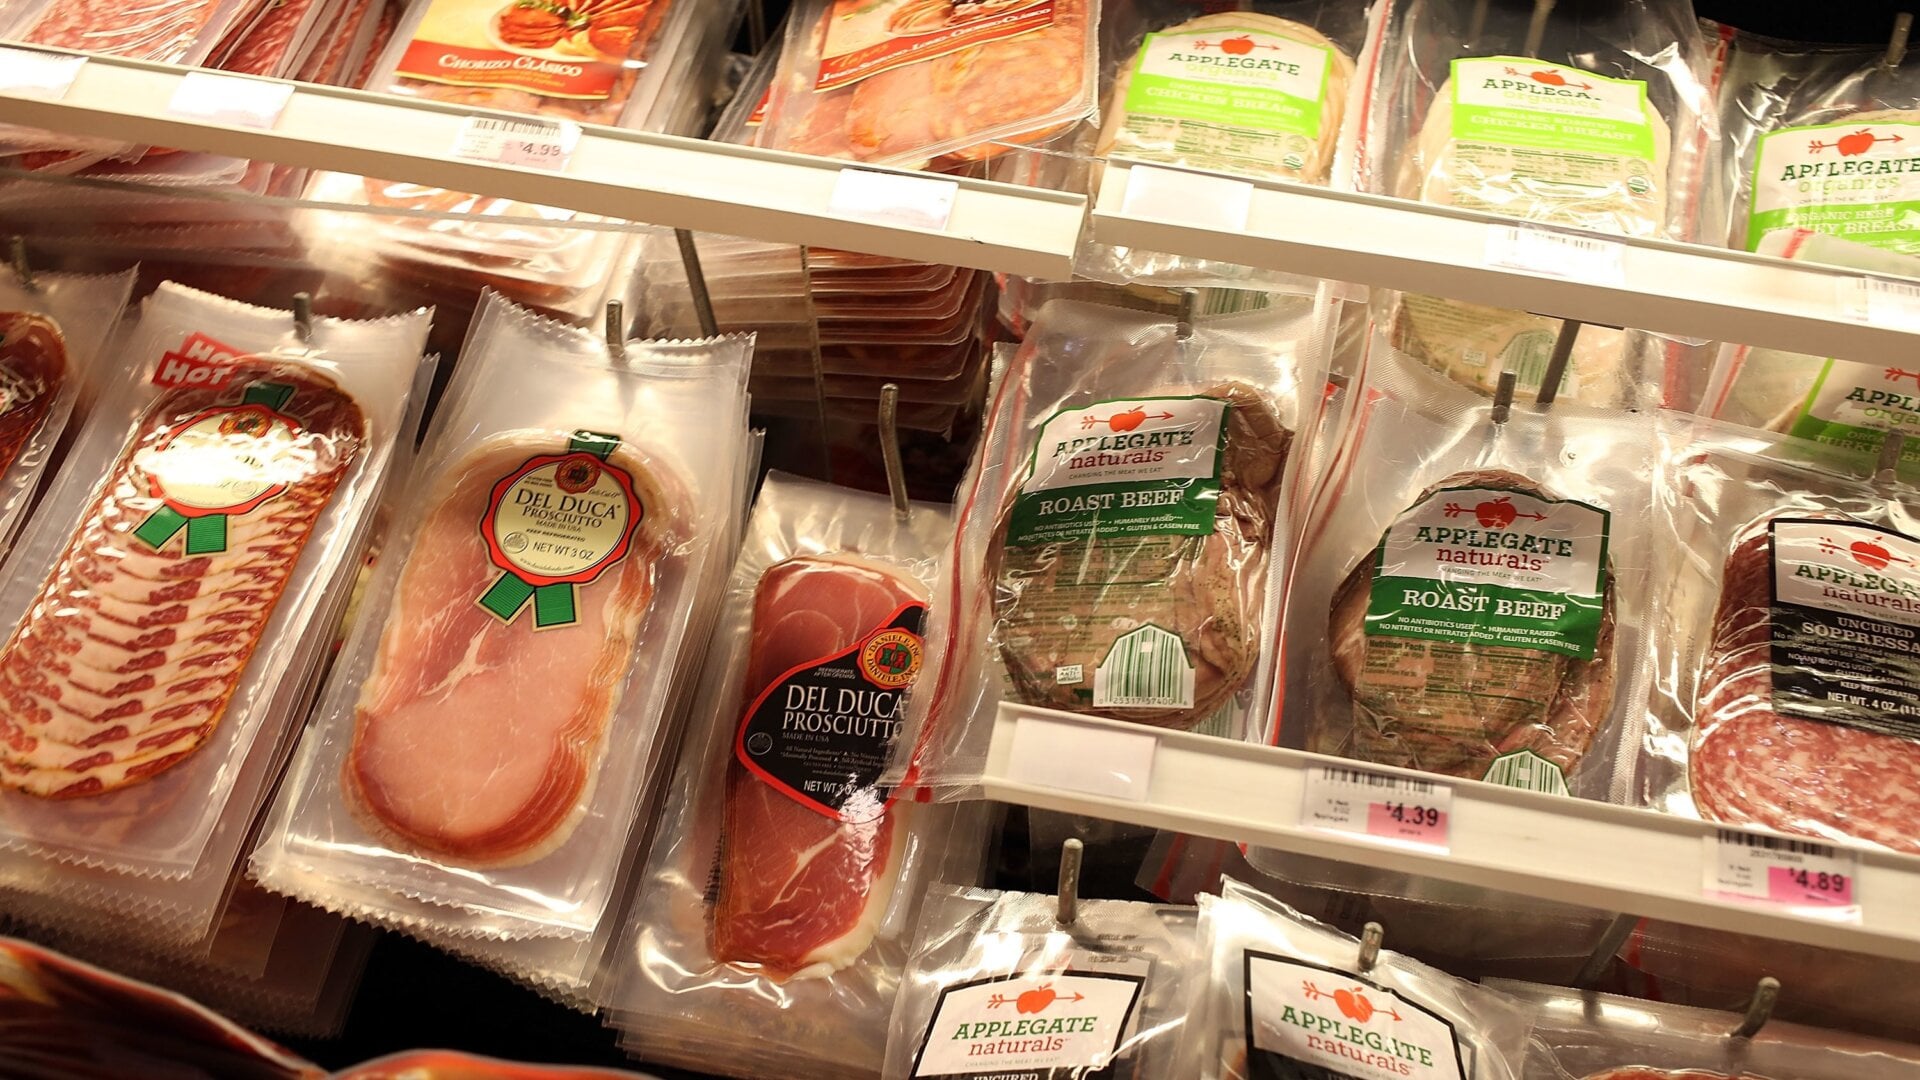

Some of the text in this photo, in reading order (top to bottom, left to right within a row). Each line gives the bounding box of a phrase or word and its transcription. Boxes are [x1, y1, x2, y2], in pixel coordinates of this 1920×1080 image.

[1168, 53, 1300, 76] APPLEGATE
[1483, 78, 1603, 102] APPLEGA
[1145, 86, 1228, 106] CHICKEN
[1232, 95, 1305, 118] BREAST
[1470, 115, 1637, 141] CHICKEN BREAST
[1780, 157, 1920, 181] APPLEGATE
[1844, 219, 1916, 235] BREAS
[161, 357, 233, 385] HOT
[1052, 430, 1194, 458] APPLEGATE
[1815, 434, 1883, 455] TURKE
[1069, 449, 1166, 470] naturals
[1069, 471, 1102, 480] CHANGING
[1118, 468, 1136, 476] MEAT
[514, 488, 554, 510] DEL
[559, 494, 619, 520] DUCA
[1038, 489, 1185, 516] ROAST BEEF
[522, 506, 603, 528] PROSCIUTTO
[536, 519, 558, 529] MADE
[566, 523, 581, 532] USA
[1034, 524, 1045, 532] NO
[1044, 521, 1084, 531] ANTIBIOTICS
[1113, 516, 1150, 525] HUMANELY
[1126, 524, 1152, 532] GLUTEN
[1158, 523, 1183, 531] CASEIN
[1183, 522, 1201, 531] FREE
[533, 541, 595, 560] NET WT 3 OZ
[1414, 526, 1573, 558] APPLEGATE
[1436, 547, 1549, 571] naturals
[1492, 571, 1511, 579] MEAT
[1401, 589, 1567, 622] ROAST BEEF
[1391, 624, 1423, 633] NITRITES
[1435, 628, 1469, 638] NITRATES
[1469, 631, 1495, 640] ADDED
[1502, 635, 1532, 644] GLUTEN
[1539, 637, 1564, 648] CASEIN
[1564, 642, 1581, 652] FREE
[1410, 617, 1455, 628] ANTIBIOTICS
[1488, 625, 1529, 636] HUMANELY
[1773, 631, 1786, 639] No
[1801, 621, 1920, 654] SOPPRESSA
[1837, 617, 1916, 639] UNCURED
[1404, 642, 1426, 652] Facts
[784, 684, 906, 719] DEL DUCA
[1112, 697, 1140, 705] 25317
[1827, 691, 1849, 703] NET
[1849, 695, 1870, 707] WT.
[1871, 699, 1879, 709] 4
[1880, 701, 1897, 711] OZ
[1840, 681, 1919, 701] KEEP REFRIGERATED
[781, 711, 906, 739] PROSCIUTTO
[782, 732, 803, 740] MADE
[803, 780, 822, 792] NET
[822, 781, 838, 794] WT
[1386, 801, 1439, 827] $4.39
[1788, 867, 1845, 893] $4.89
[951, 1016, 1098, 1040] APPLEGATE
[1281, 1005, 1433, 1067] APPLEGATE
[967, 1036, 1064, 1057] naturals
[1306, 1034, 1411, 1076] naturals
